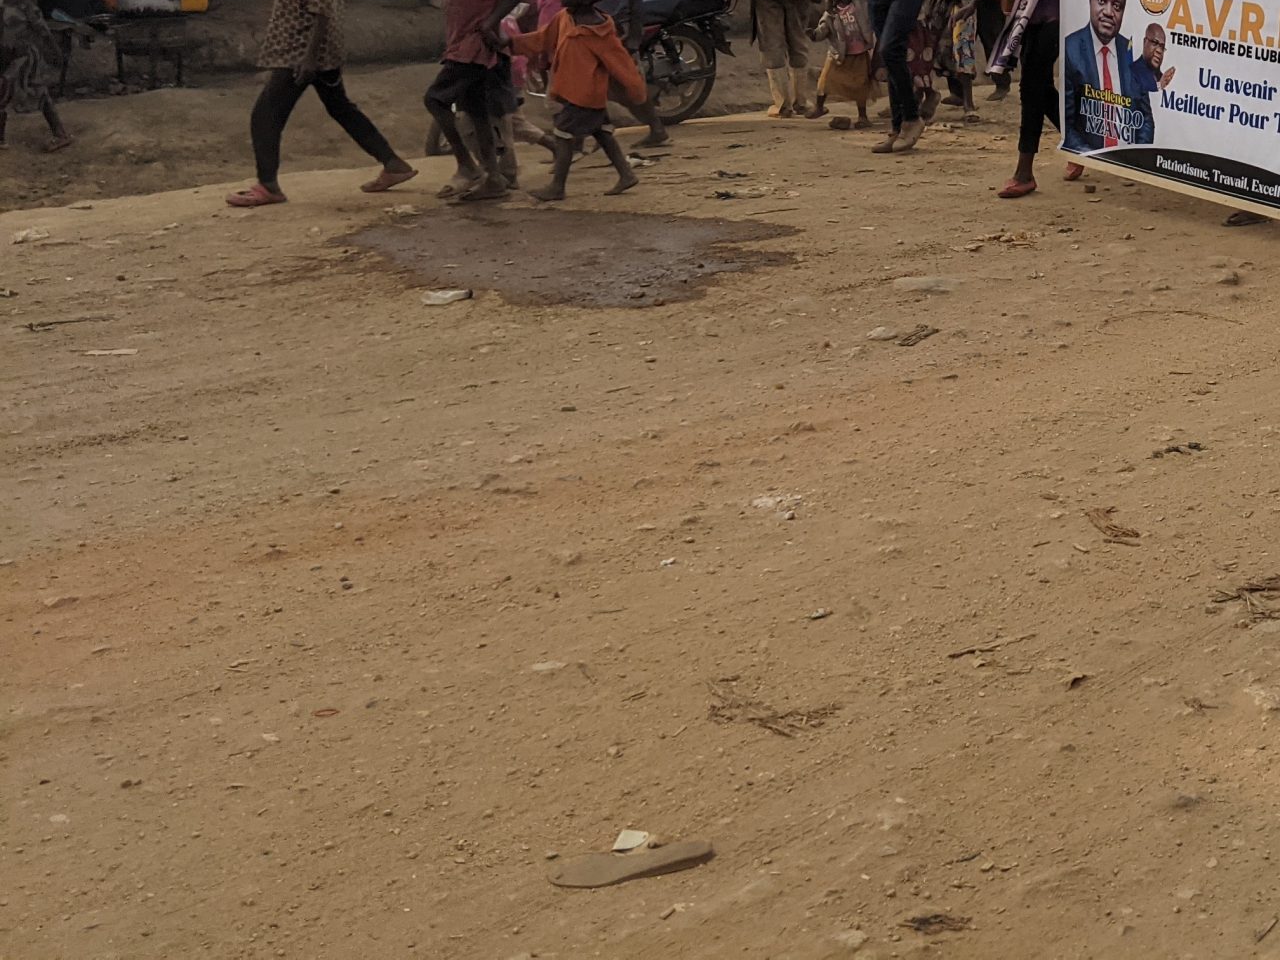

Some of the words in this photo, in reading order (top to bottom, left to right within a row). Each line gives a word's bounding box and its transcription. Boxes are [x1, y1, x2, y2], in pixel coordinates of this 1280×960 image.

[1170, 31, 1235, 55] TERRITOIRE
[1237, 44, 1253, 58] DE
[1083, 83, 1132, 107] Excellence
[1199, 67, 1221, 90] Un
[1224, 77, 1278, 101] avenir
[1080, 96, 1144, 129] MUHINDO
[1160, 89, 1225, 120] Meilleur
[1228, 103, 1270, 130] Pour
[1086, 115, 1136, 144] NZANGI
[1156, 155, 1210, 181] Patriotisme,
[1212, 168, 1249, 191] Travail,
